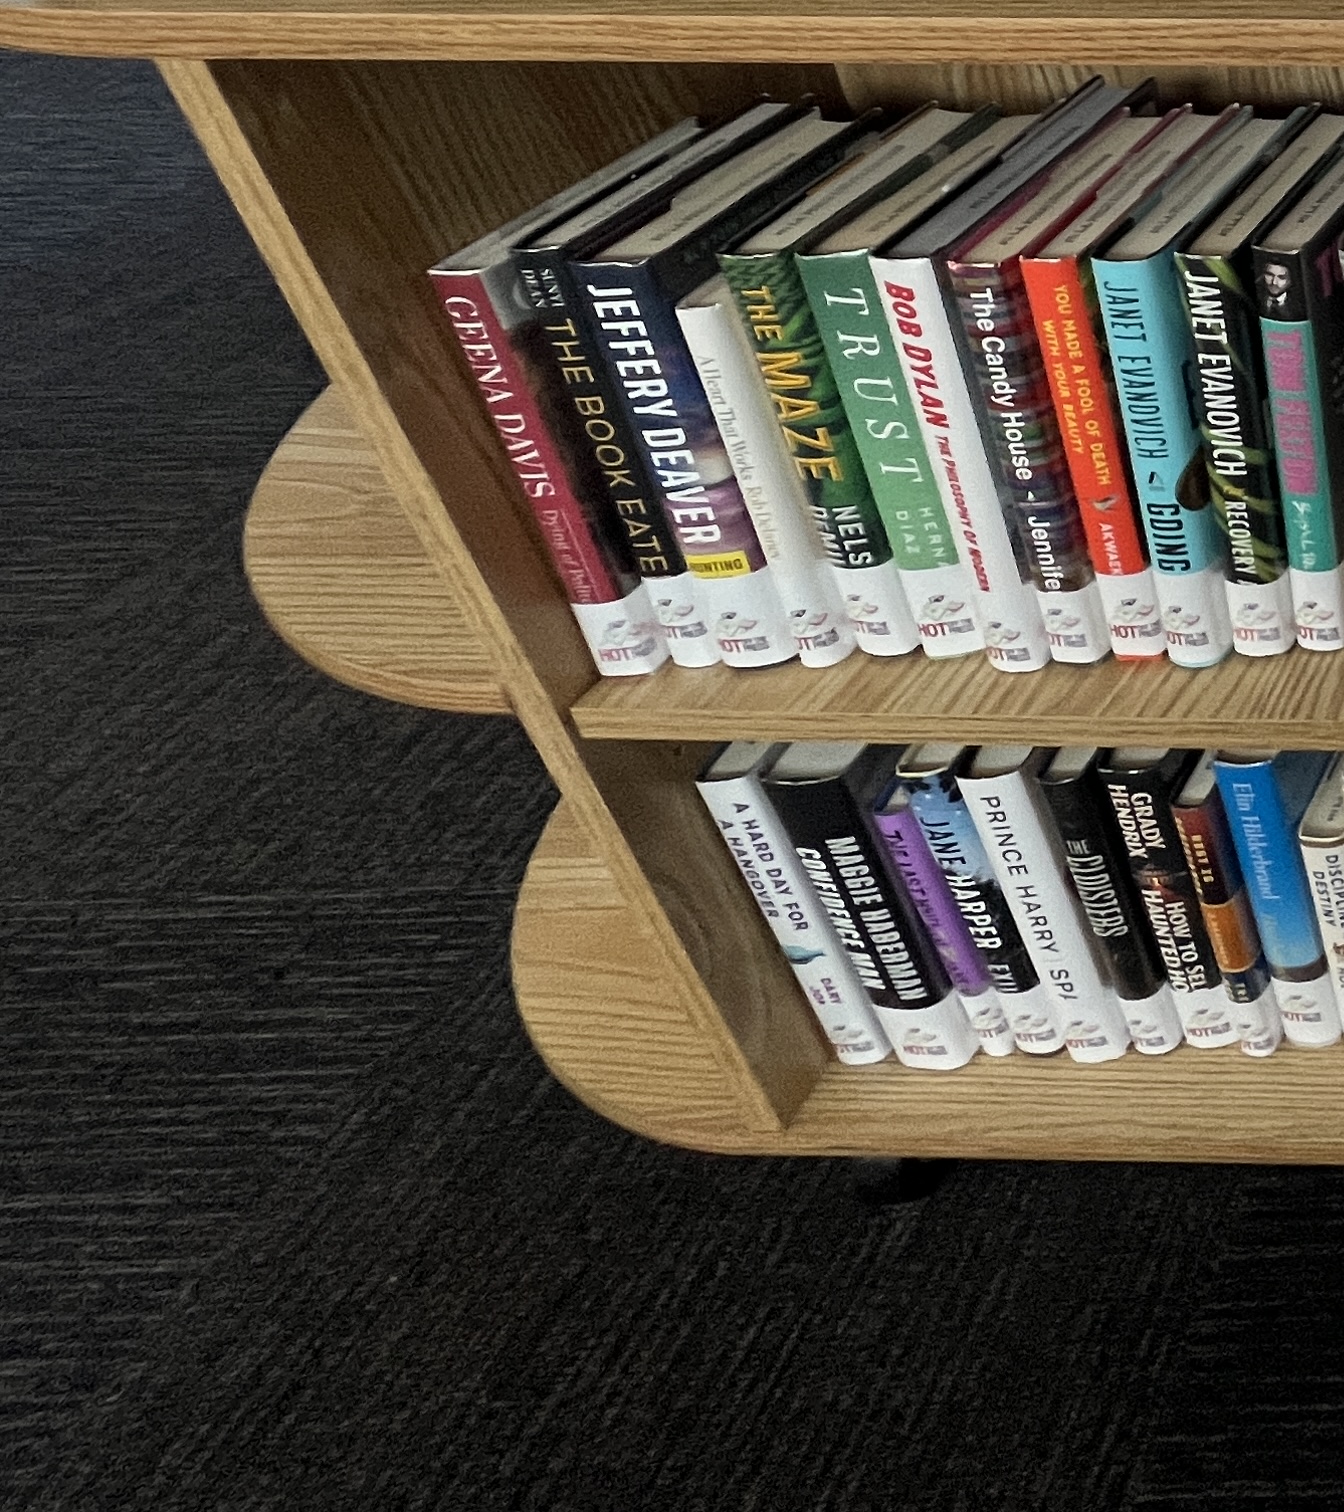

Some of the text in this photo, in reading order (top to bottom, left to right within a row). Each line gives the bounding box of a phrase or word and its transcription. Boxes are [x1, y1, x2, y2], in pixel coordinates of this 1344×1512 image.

[445, 297, 555, 498] GEENA DAVIS
[546, 319, 633, 487] THE BOOK
[590, 285, 721, 543] JEFFERY DEAVER
[741, 286, 841, 481] THE MAZE
[824, 288, 923, 483] TRUST
[883, 281, 950, 428] BOB DYLAN
[968, 288, 1031, 480] The Candy House
[1055, 285, 1110, 485] YOU MADE FOOL OF DEATH
[1105, 282, 1169, 458] JANET EVANOVICH
[1184, 270, 1246, 475] JANET EVANOVICH
[1148, 503, 1191, 572] GOING
[1224, 502, 1254, 573] RECOVERY
[742, 820, 809, 931] HARD DAY FOR
[825, 836, 883, 906] MAGGIE
[920, 818, 1002, 950] JANE HARPER
[980, 796, 1028, 877] PRINCE
[1107, 784, 1166, 859] GRADY HENDRIX
[796, 847, 865, 949] CONFIDENCE
[1015, 885, 1060, 954] HARRY
[1312, 871, 1336, 927] DESTINY
